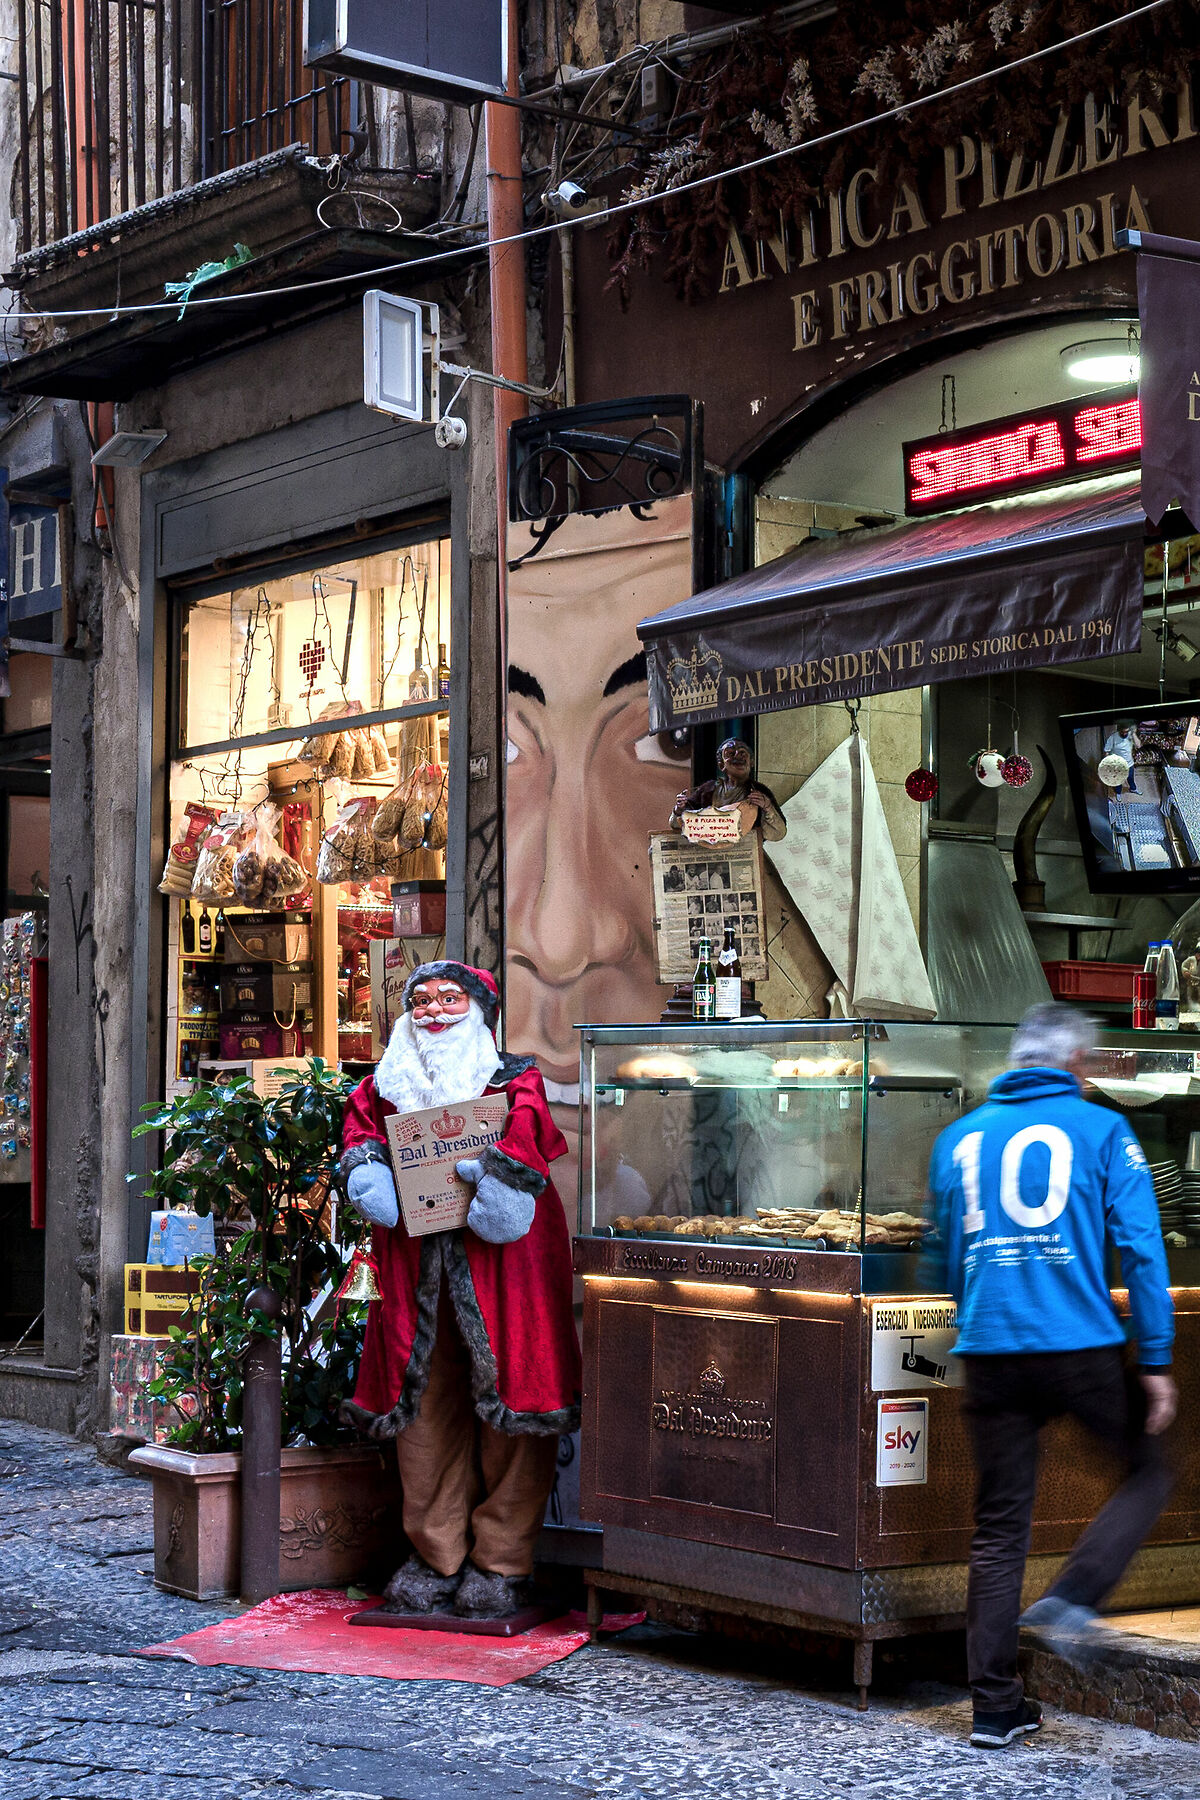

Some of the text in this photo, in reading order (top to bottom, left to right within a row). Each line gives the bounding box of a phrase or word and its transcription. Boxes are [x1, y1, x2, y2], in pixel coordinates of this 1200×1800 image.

[718, 167, 929, 293] ANTICA
[790, 184, 1151, 351] E FRIGGITORIA
[726, 618, 1112, 703] DAL PRESIDENTE SEDE STORICA DAL 1936
[397, 1144, 427, 1164] Dal
[952, 1124, 1075, 1234] 10
[623, 1247, 798, 1280] Eccellenza Campana 2018
[876, 1310, 909, 1331] ESERCIZIO
[689, 1406, 773, 1442] Presidente
[884, 1425, 921, 1455] sky
